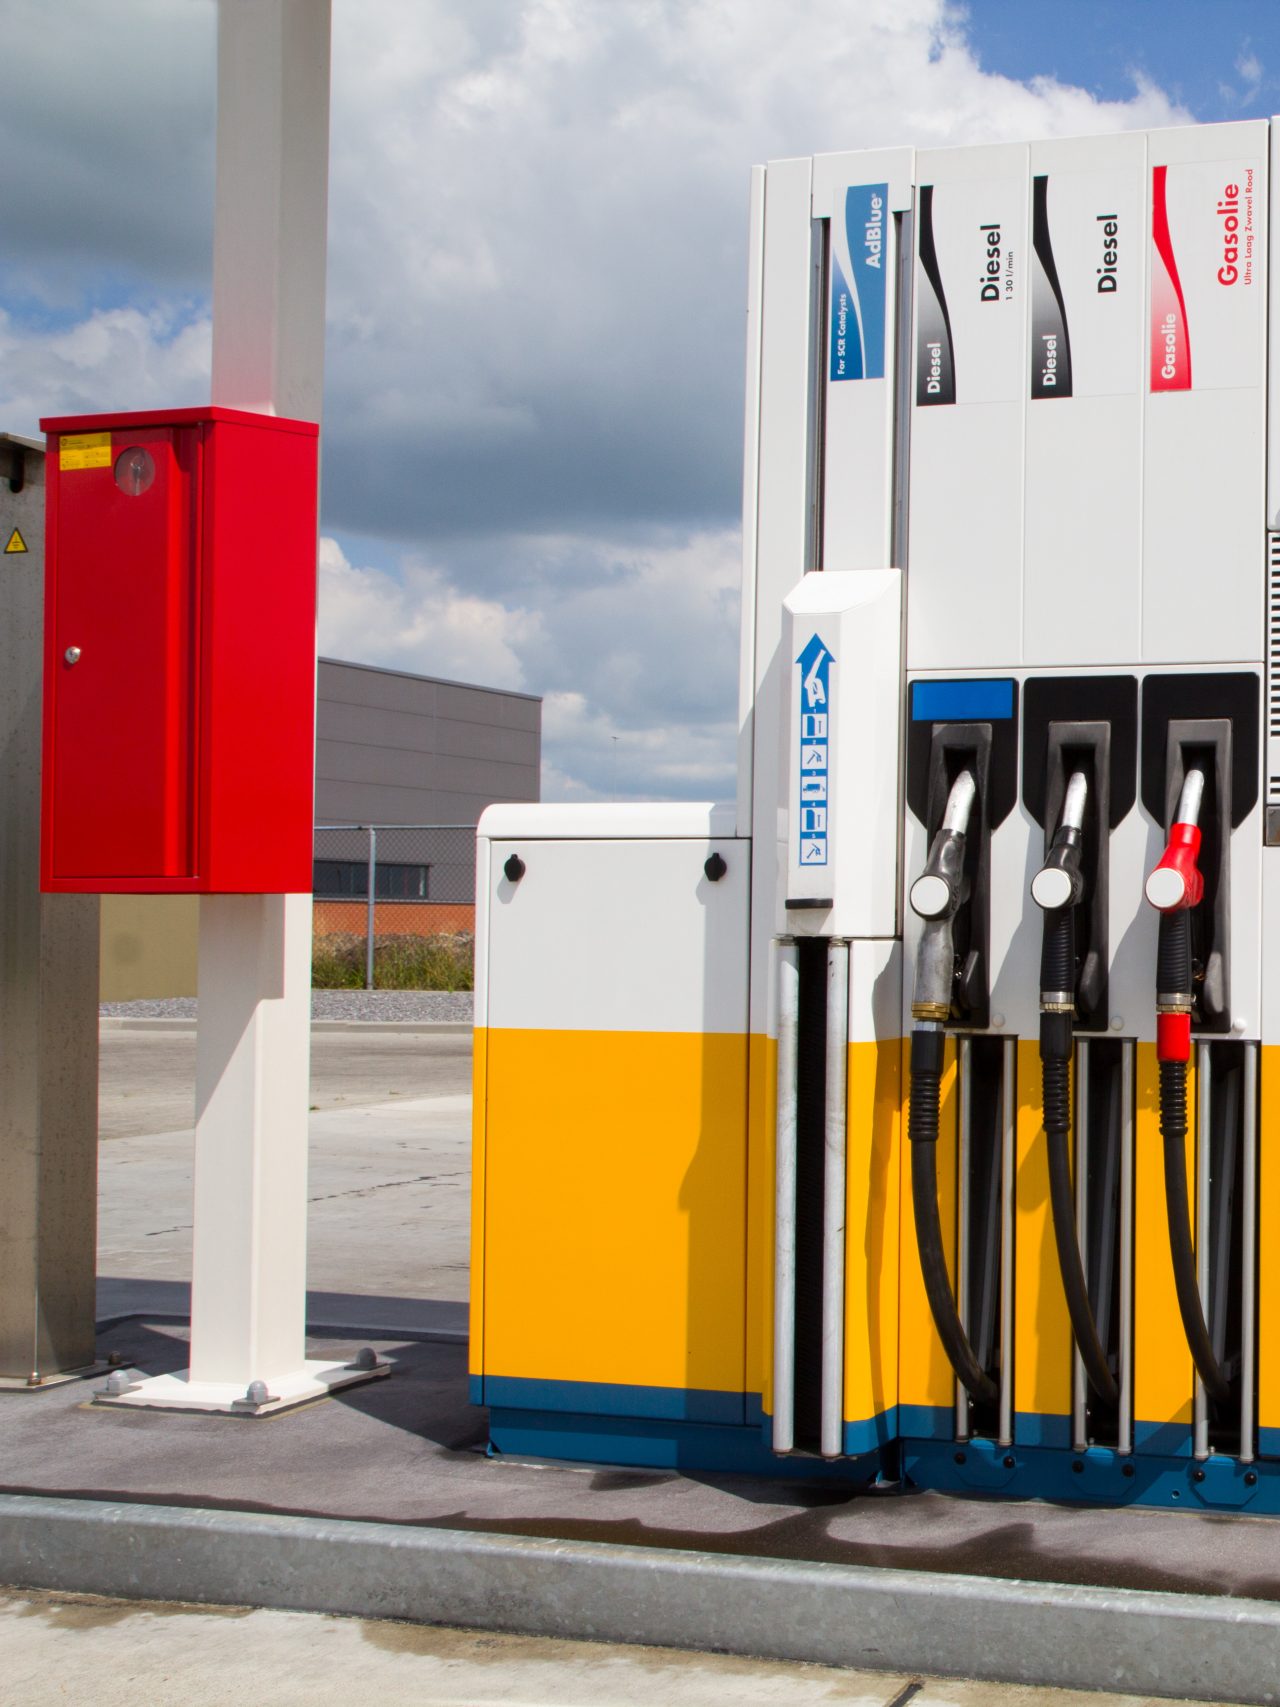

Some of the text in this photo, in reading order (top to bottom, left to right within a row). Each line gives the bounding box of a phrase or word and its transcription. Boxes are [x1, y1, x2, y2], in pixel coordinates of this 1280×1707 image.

[980, 224, 1001, 301] Diesel
[1096, 214, 1118, 293] Diesel
[1216, 183, 1239, 286] Gasolie
[1244, 169, 1254, 285] Ultra Laag Zwavel Rood
[837, 294, 848, 375] For SCR Catalysts
[927, 342, 941, 394] Diesel
[1042, 334, 1057, 386] Diesel
[1161, 313, 1176, 379] Gasolie
